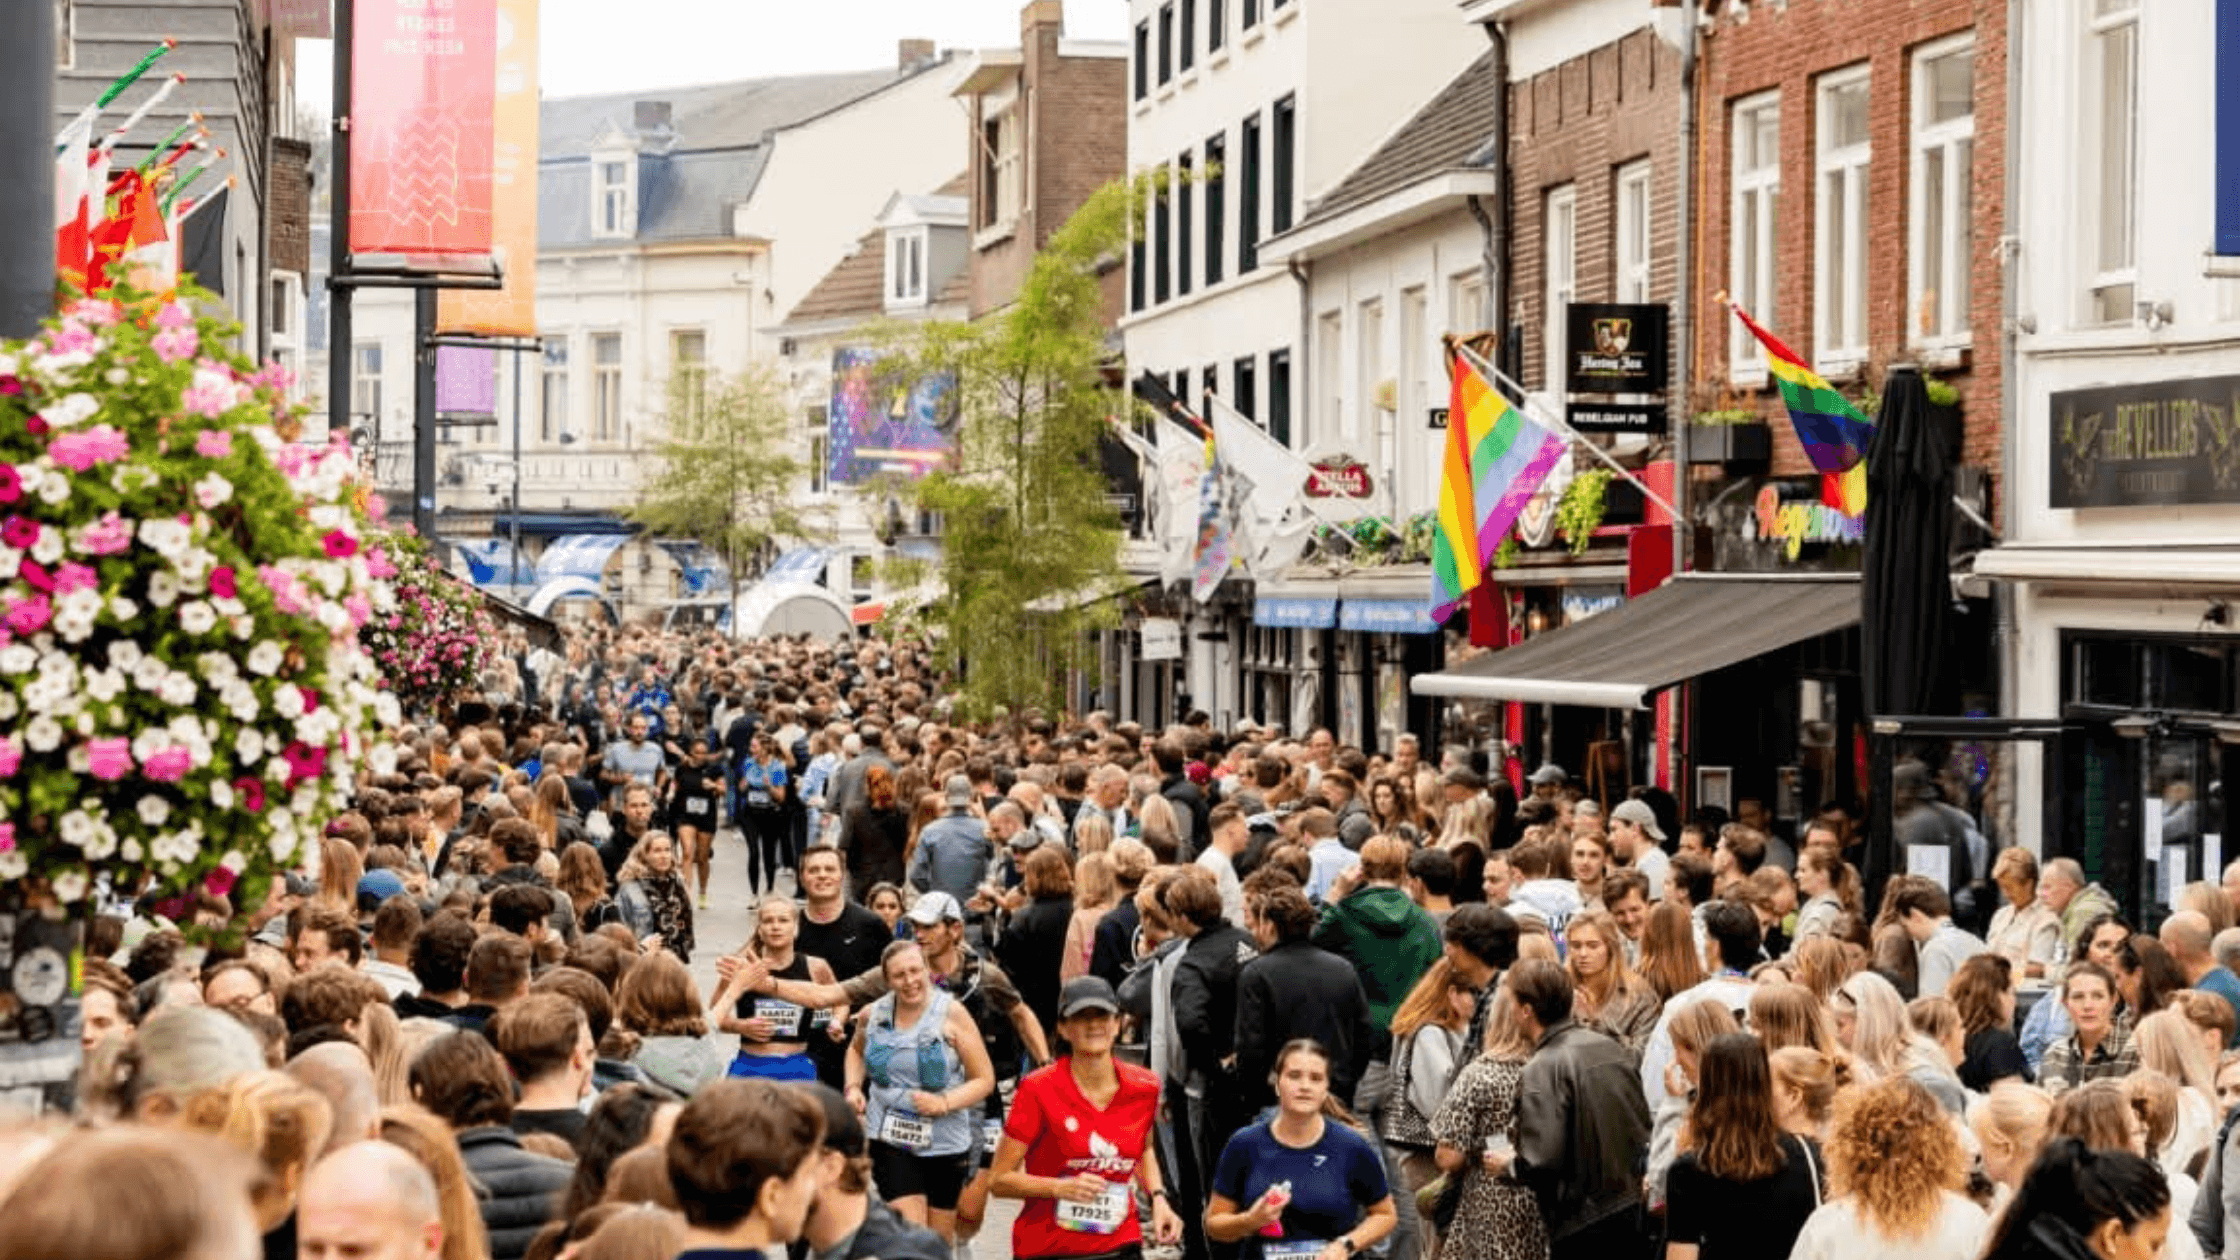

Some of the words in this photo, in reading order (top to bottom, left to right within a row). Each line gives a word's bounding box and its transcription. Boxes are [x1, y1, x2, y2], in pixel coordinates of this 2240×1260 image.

[1628, 413, 1648, 424] PUB
[2116, 399, 2198, 460] REVELLERS
[1072, 1206, 1112, 1221] 17925
